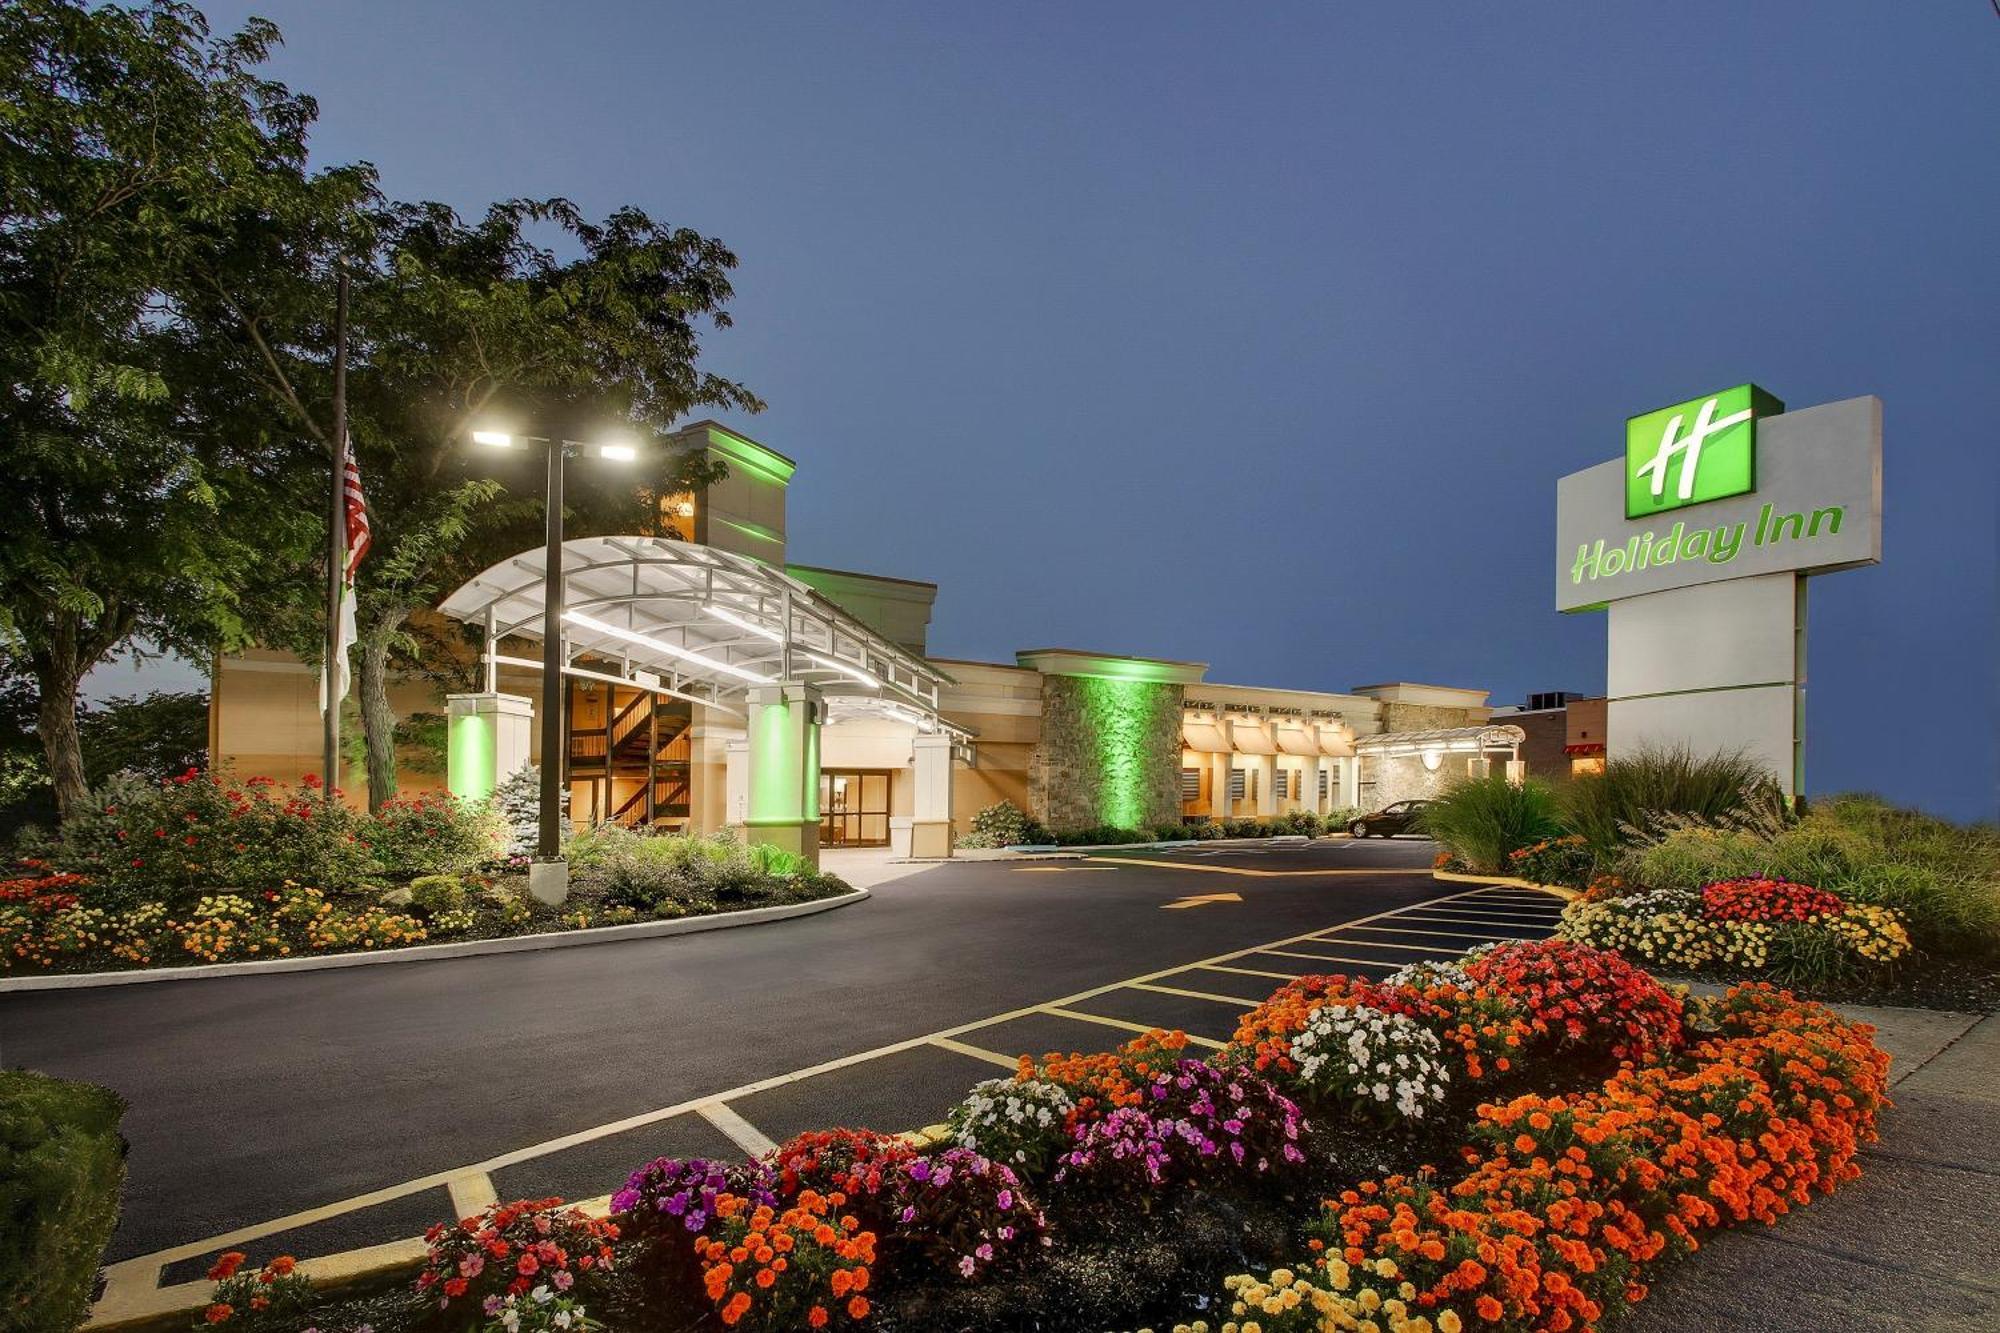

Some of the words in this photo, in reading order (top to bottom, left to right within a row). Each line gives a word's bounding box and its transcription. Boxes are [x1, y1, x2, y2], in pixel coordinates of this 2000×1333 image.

[1636, 399, 1753, 500] H
[1571, 522, 1746, 584] Holiday
[1754, 503, 1845, 546] Inn
